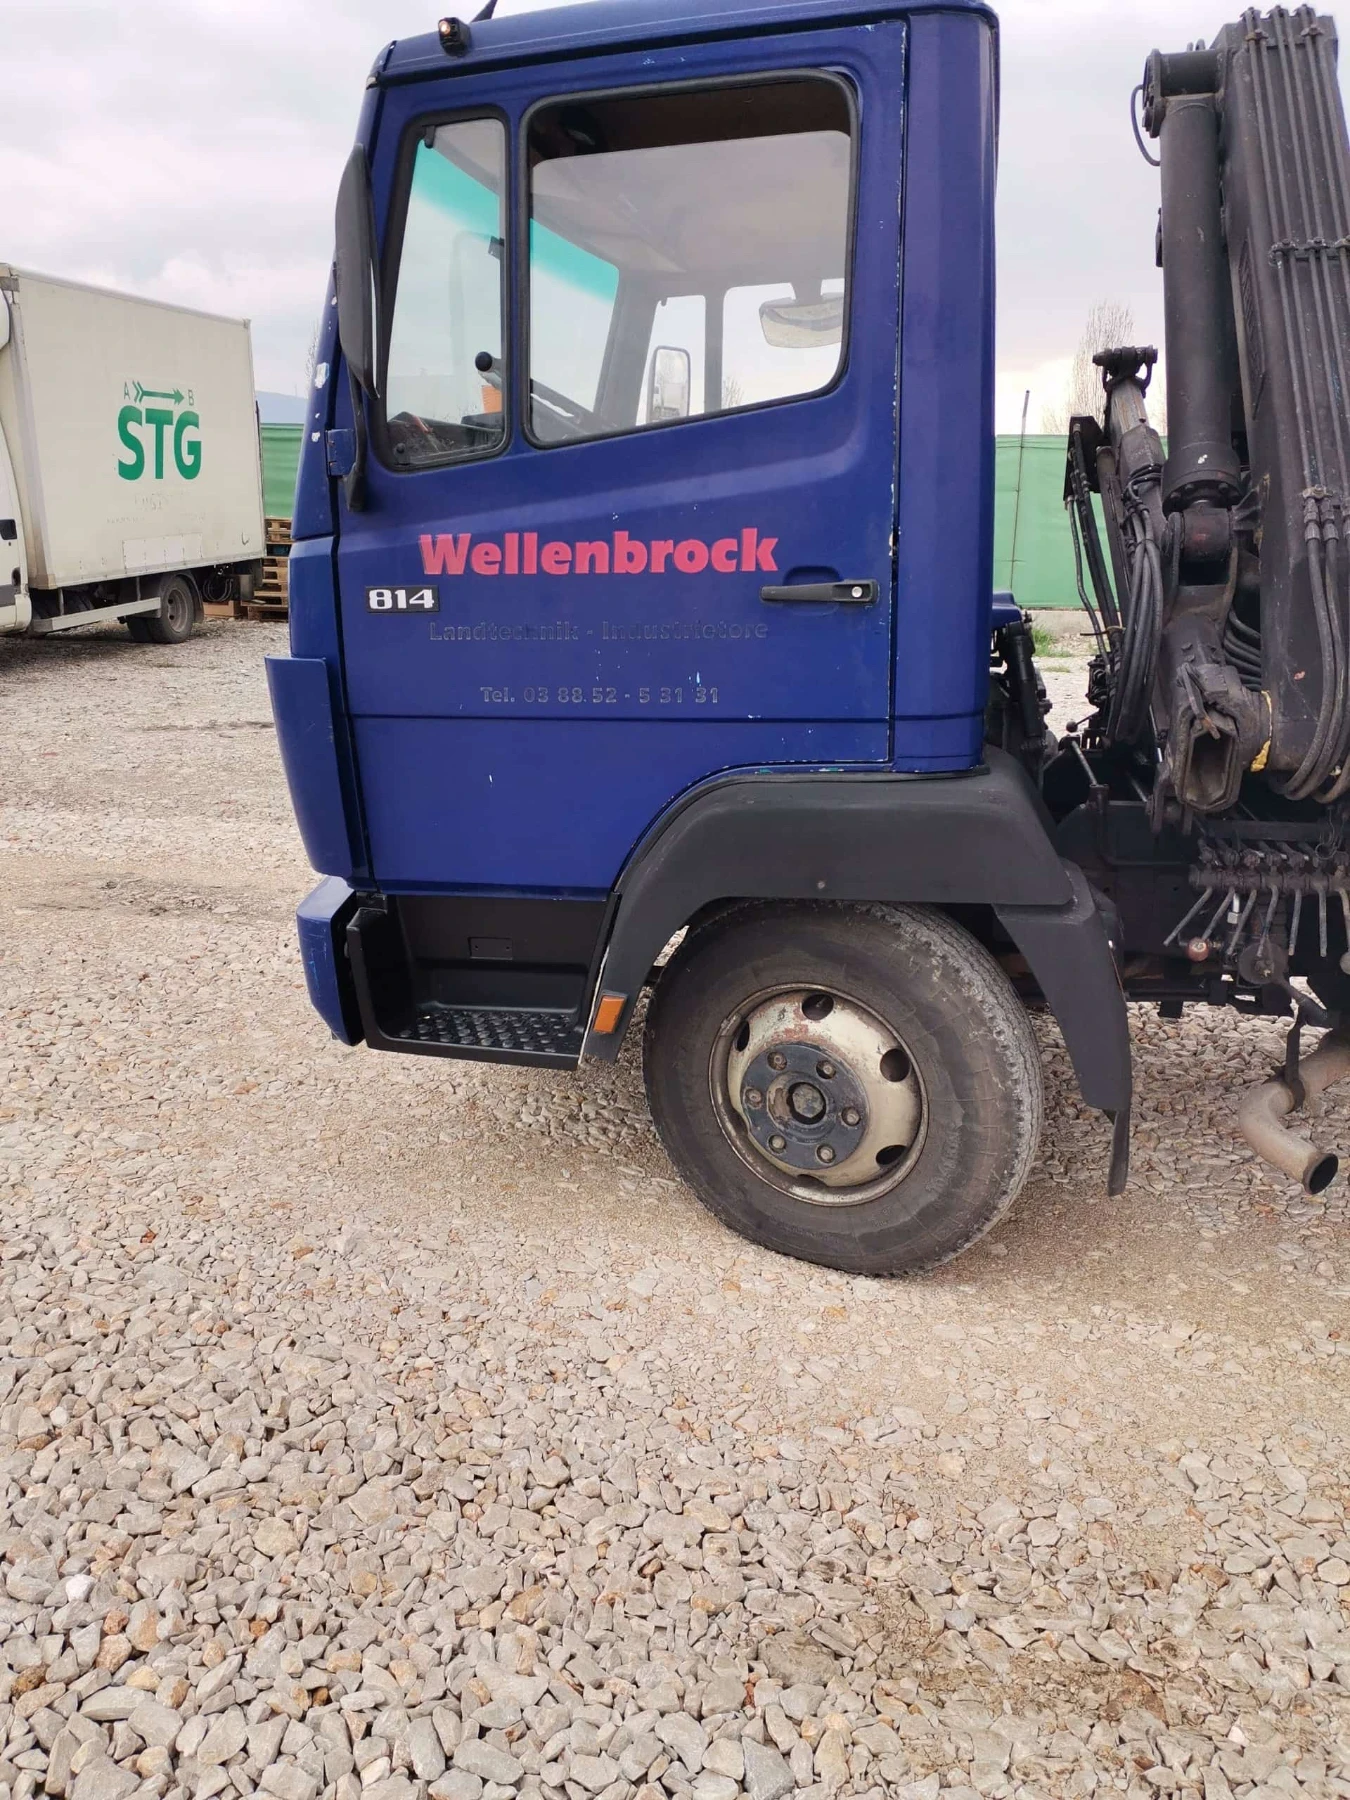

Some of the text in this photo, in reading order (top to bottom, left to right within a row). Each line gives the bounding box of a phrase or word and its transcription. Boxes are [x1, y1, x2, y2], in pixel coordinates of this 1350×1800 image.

[123, 381, 194, 406] A B
[118, 405, 202, 481] STG
[419, 527, 779, 575] Wellenbrock
[368, 588, 435, 610] 814
[480, 687, 515, 703] Tel.
[523, 687, 549, 703] 03
[639, 687, 651, 704] 5
[660, 687, 683, 704] 31
[695, 687, 718, 703] 31
